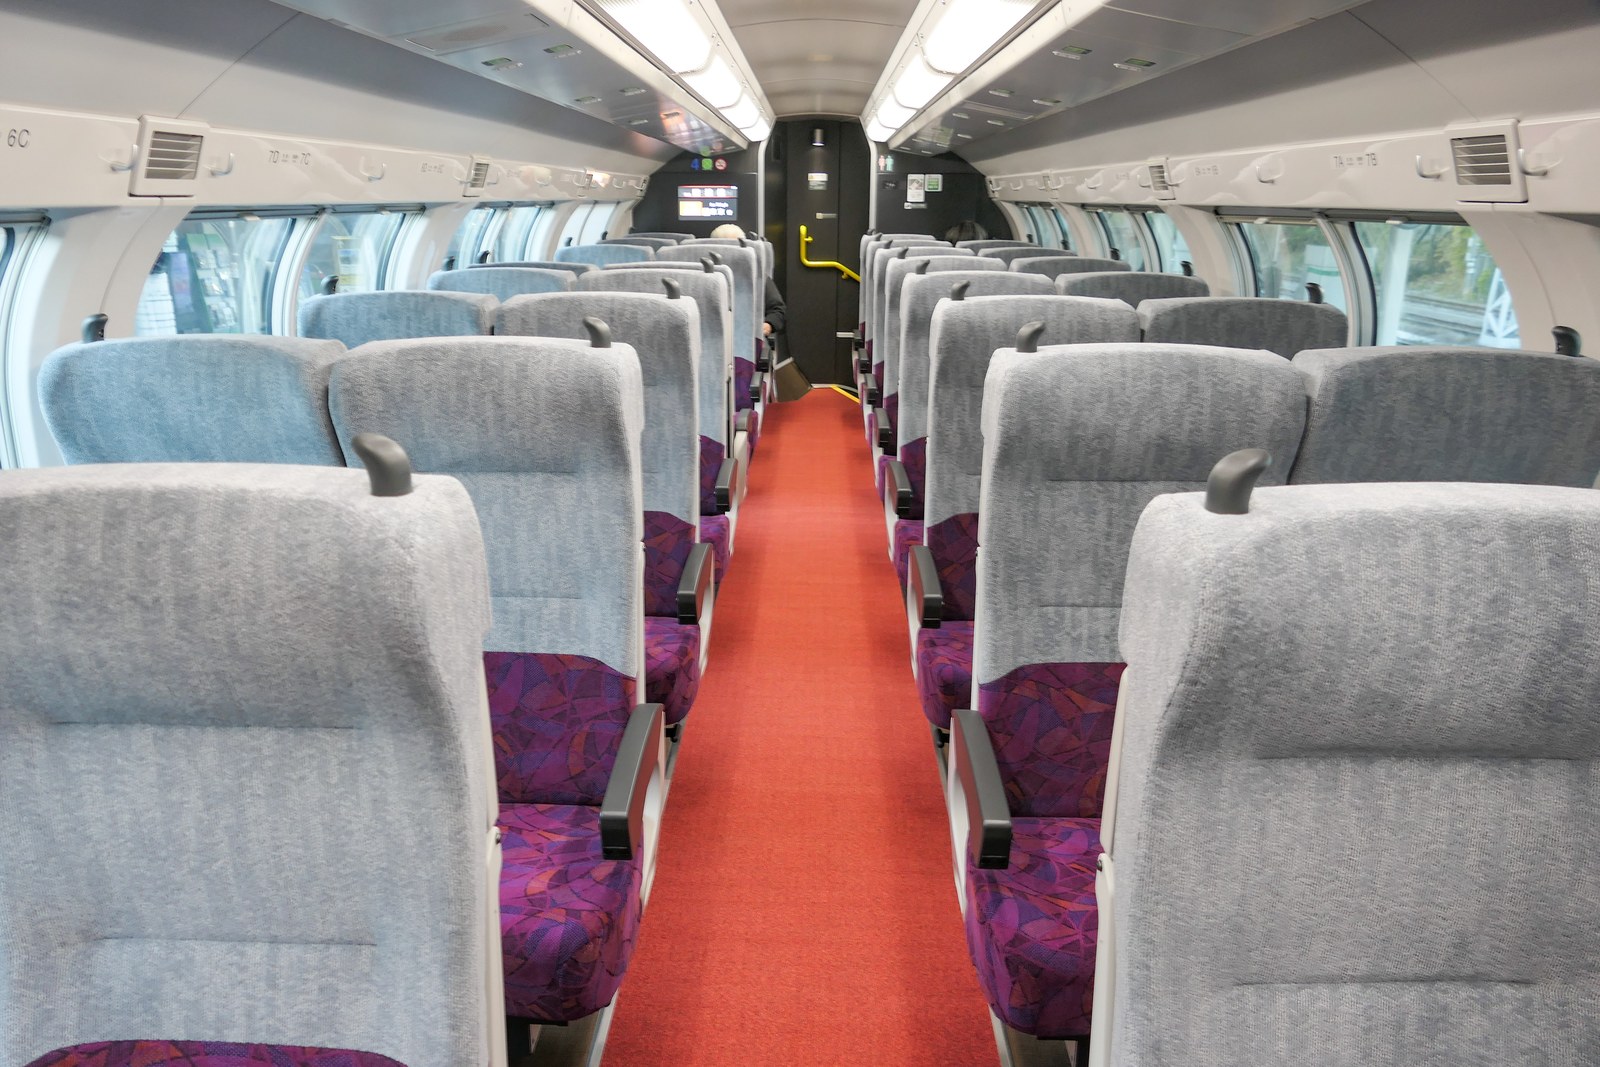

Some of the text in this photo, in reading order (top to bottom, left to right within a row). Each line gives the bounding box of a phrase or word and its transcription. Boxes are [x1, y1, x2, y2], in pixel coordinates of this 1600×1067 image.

[7, 128, 30, 148] 6C
[1333, 155, 1345, 168] 7A
[1365, 152, 1377, 167] 7B
